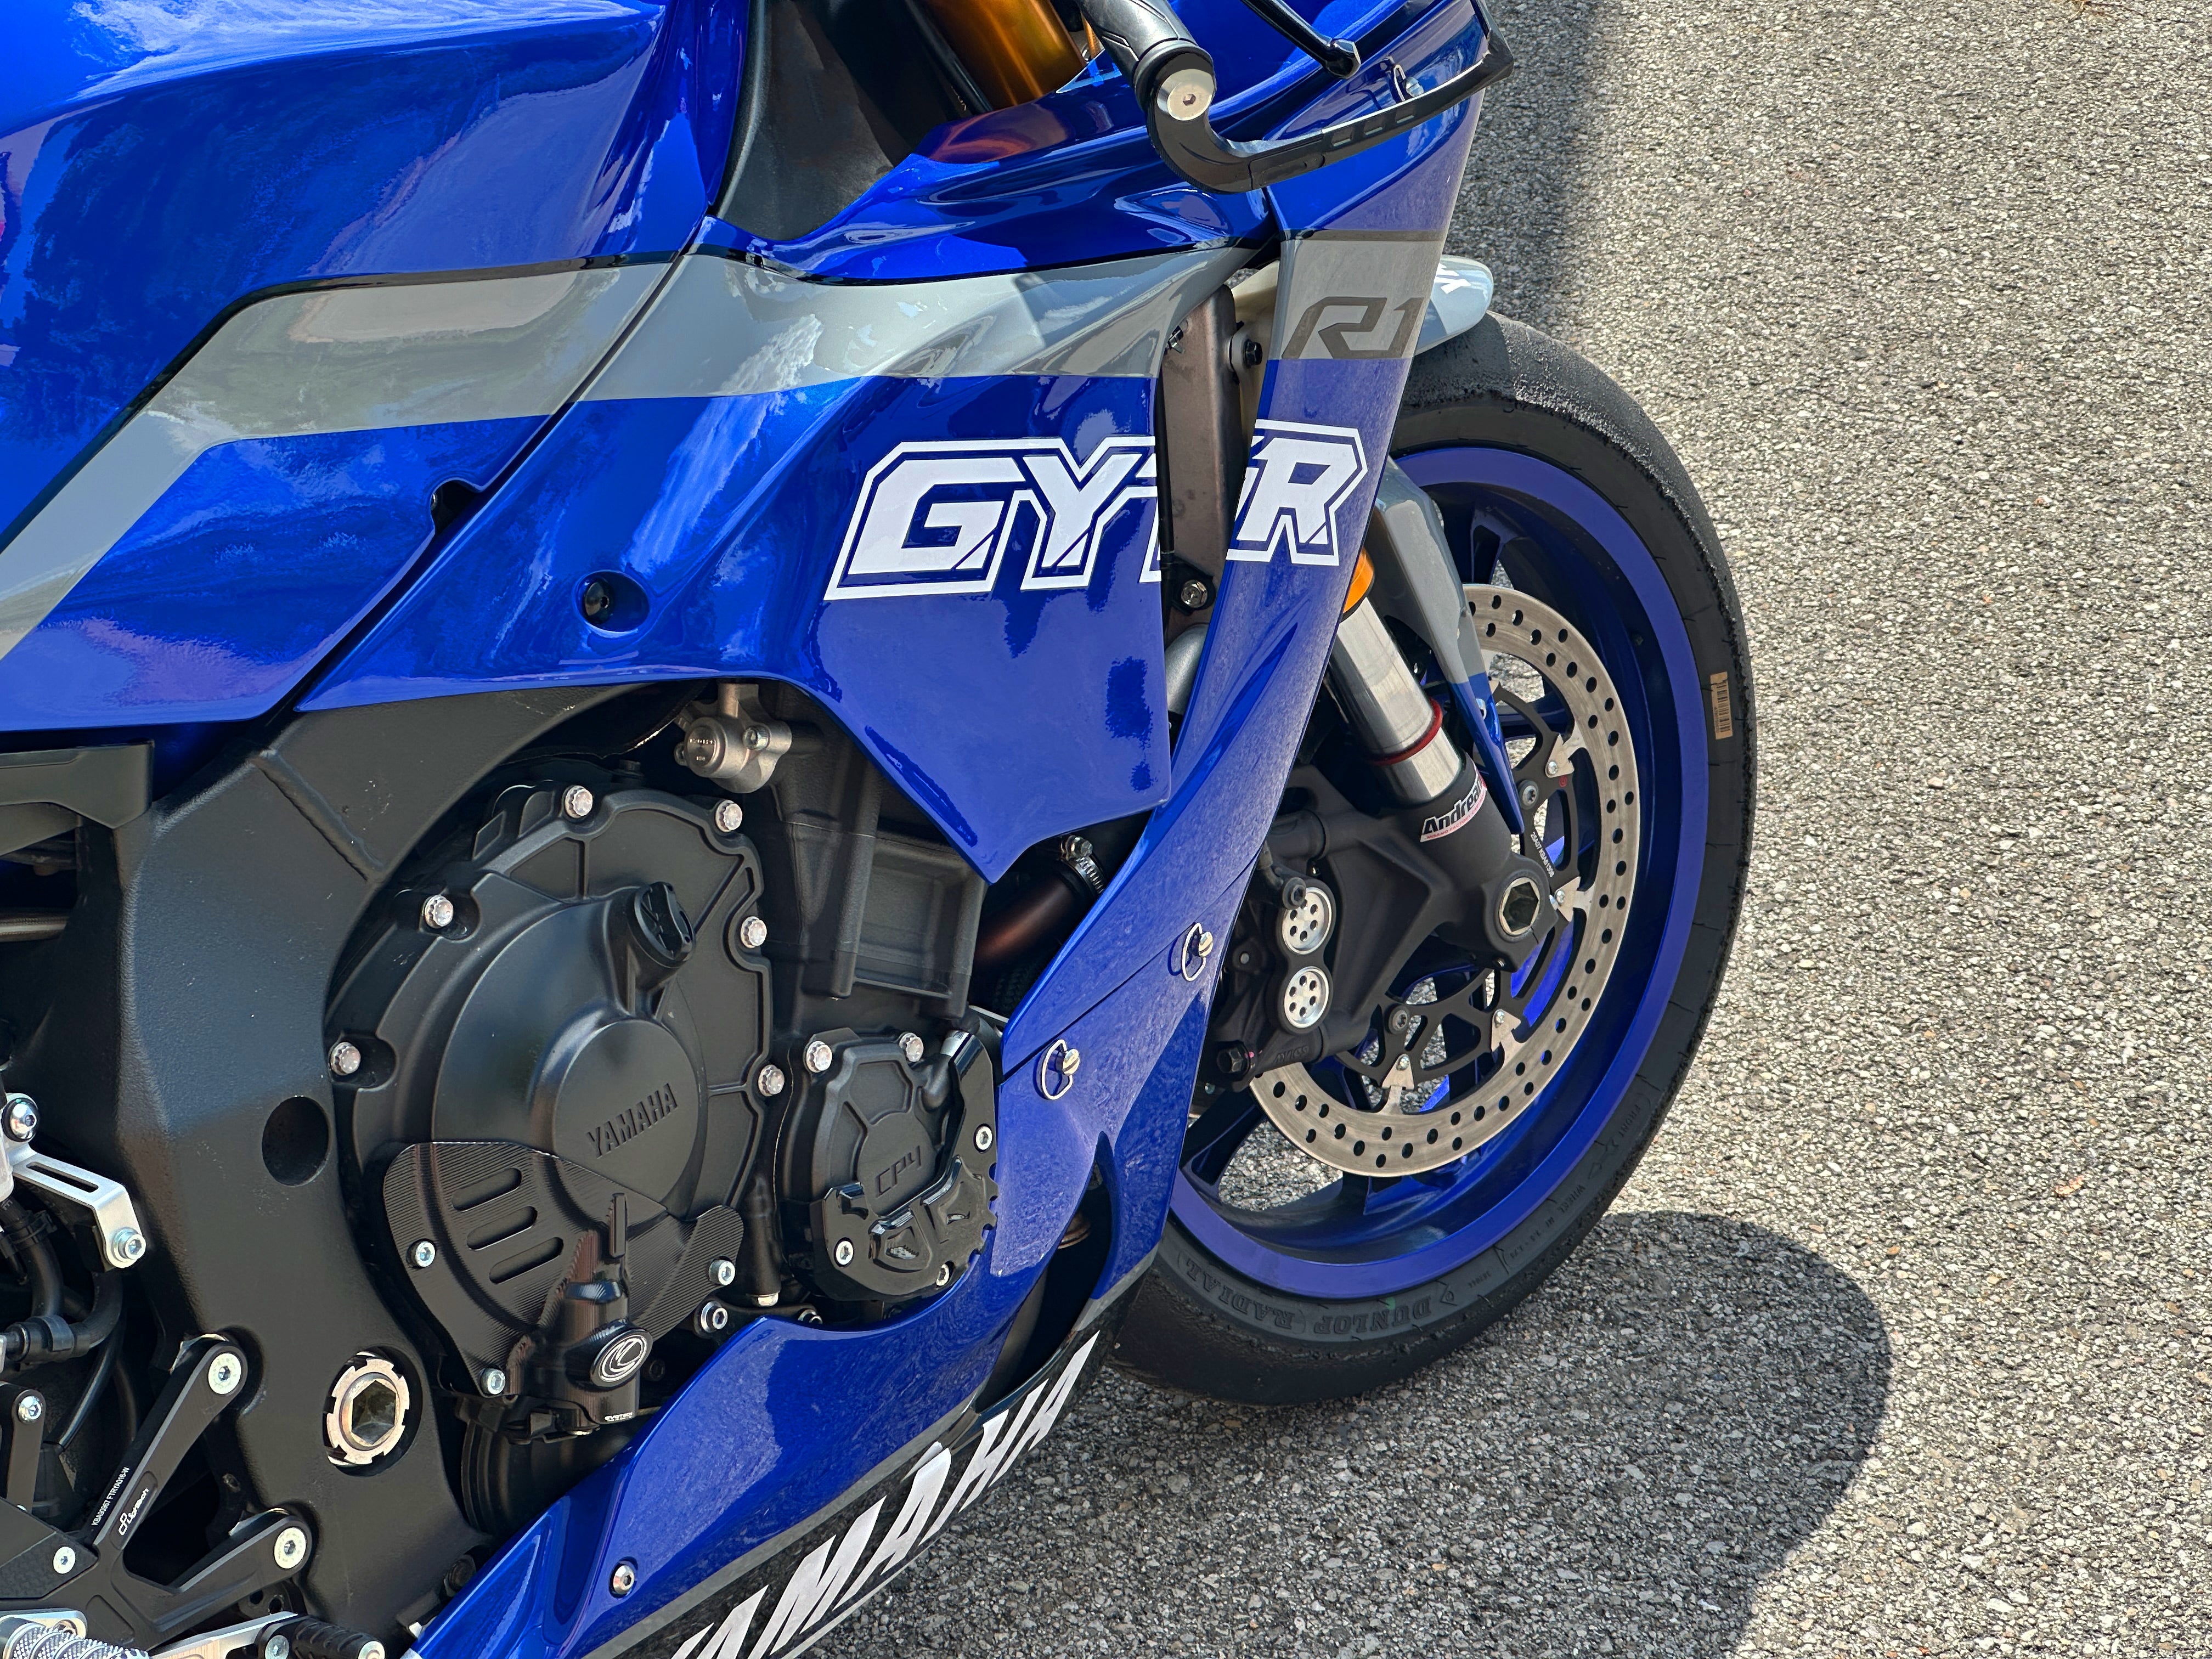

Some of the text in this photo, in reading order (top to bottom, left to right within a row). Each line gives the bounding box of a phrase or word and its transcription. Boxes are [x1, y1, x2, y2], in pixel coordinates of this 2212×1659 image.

[1282, 296, 1424, 359] R1
[823, 419, 1368, 601] GYR
[585, 1082, 678, 1159] YAMAHA
[1186, 1257, 1432, 1335] DUNLOP RADIAL
[671, 1330, 1100, 1659] AMAHA
